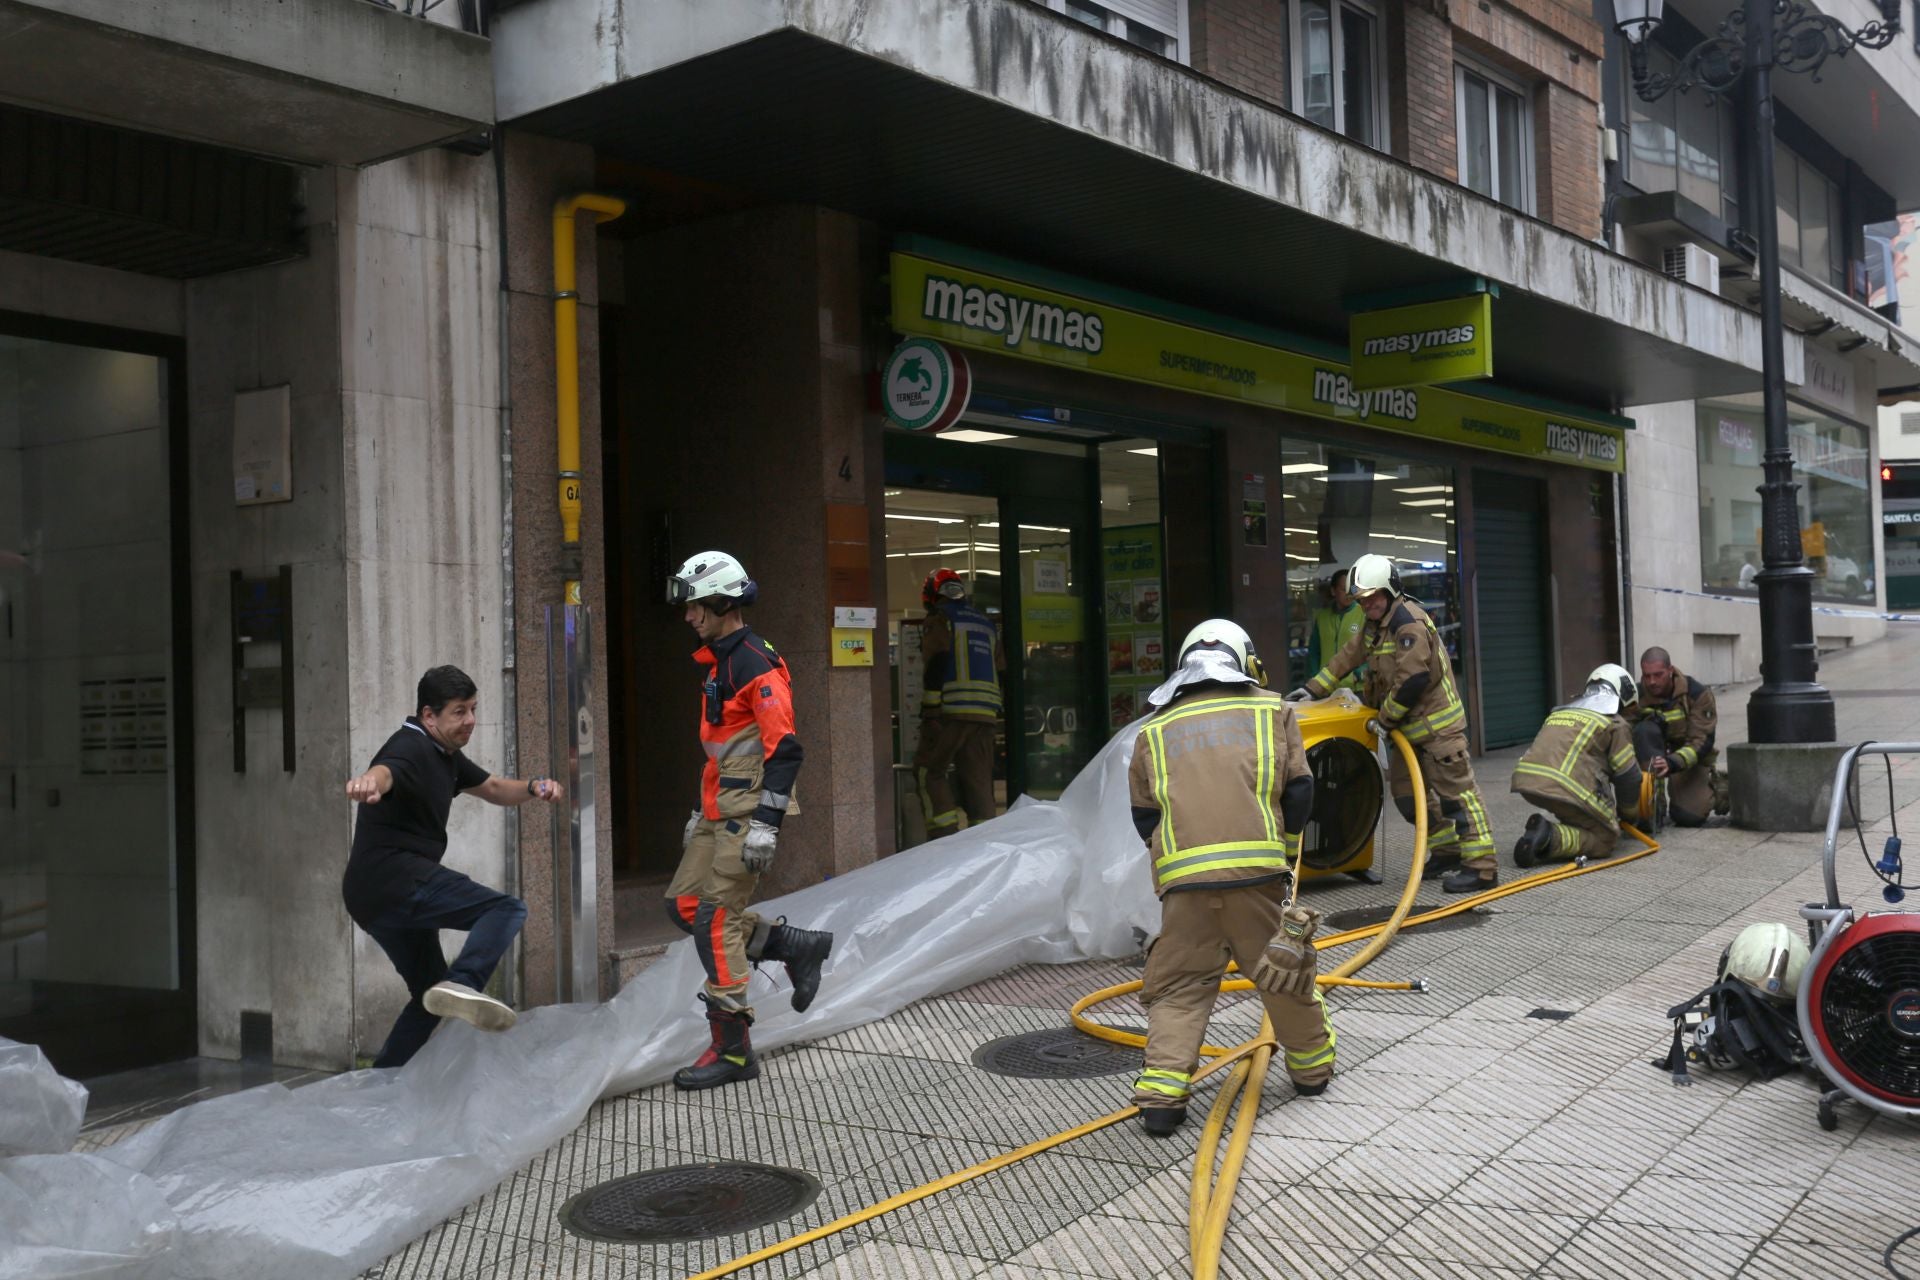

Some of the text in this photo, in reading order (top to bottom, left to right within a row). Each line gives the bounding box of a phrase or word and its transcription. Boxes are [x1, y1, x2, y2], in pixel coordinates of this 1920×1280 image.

[924, 278, 1103, 353] masymas
[1363, 324, 1475, 356] masymas
[1159, 350, 1257, 385] SUPERMERCADOS
[896, 391, 922, 403] TERNERA
[1546, 424, 1616, 460] masymas
[839, 456, 852, 482] 4
[566, 486, 581, 501] GA
